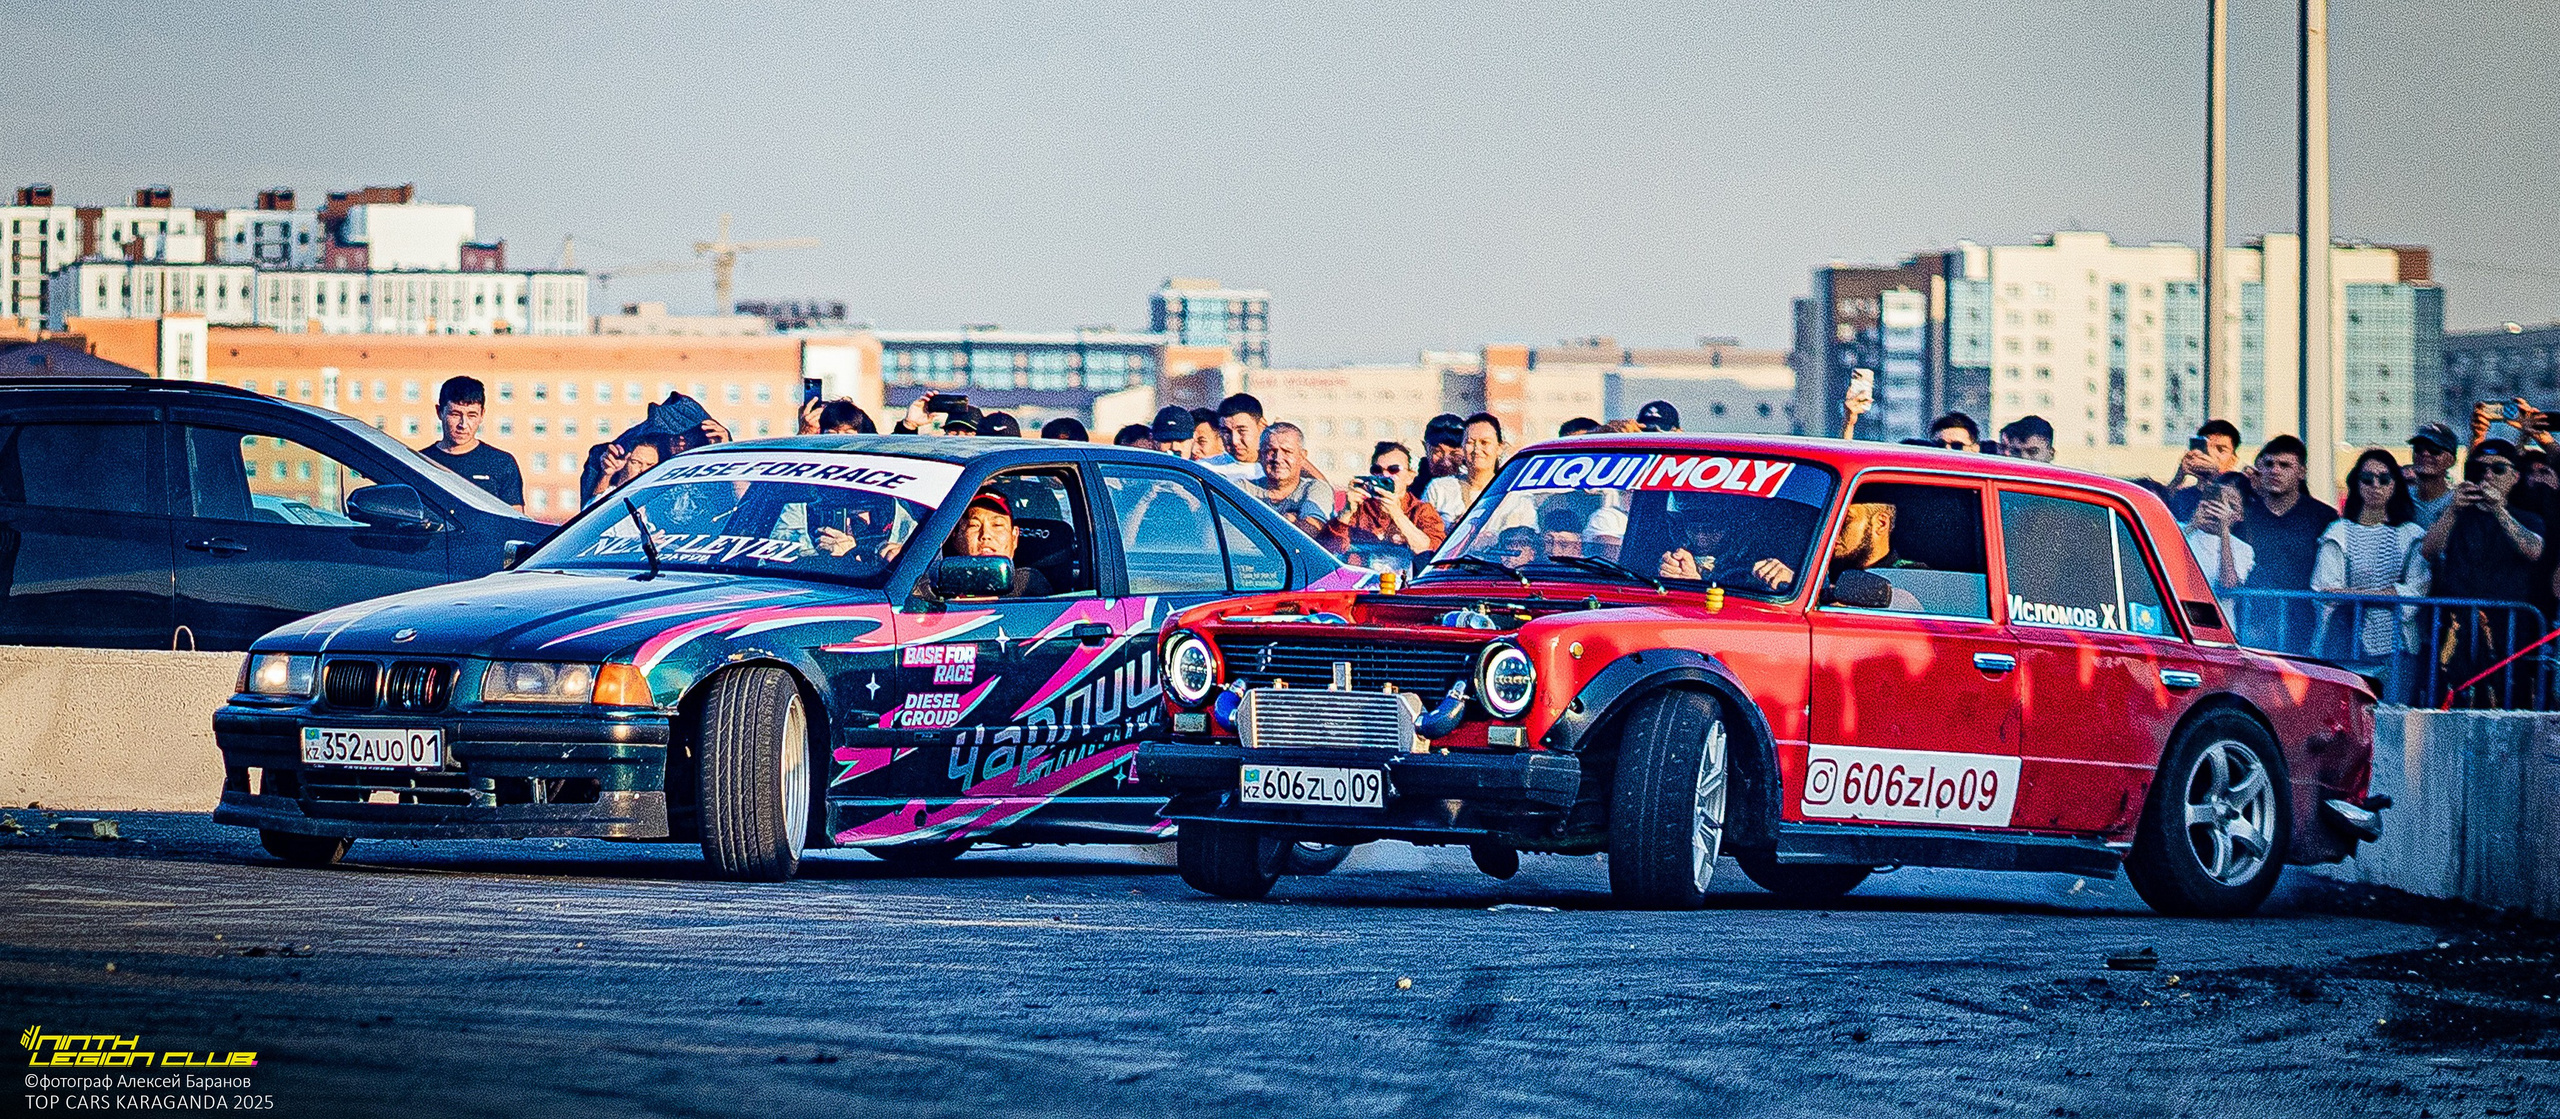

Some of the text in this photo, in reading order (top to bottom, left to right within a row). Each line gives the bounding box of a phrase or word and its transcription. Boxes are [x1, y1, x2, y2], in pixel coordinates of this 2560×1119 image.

[652, 461, 917, 490] BASE FOR RACE
[1518, 455, 1781, 492] LIQUI MOLY
[673, 533, 806, 563] LEVEL
[2007, 593, 2098, 629] Исломов
[903, 646, 976, 665] BASE FOR
[933, 664, 975, 684] RACE
[904, 693, 961, 710] DIESEL
[901, 710, 960, 728] GROUP
[322, 732, 404, 762] 352AUO
[410, 734, 440, 763] 01
[1243, 770, 1380, 804] KZ 606ZLO 09
[1843, 762, 1999, 812] 606zlo09
